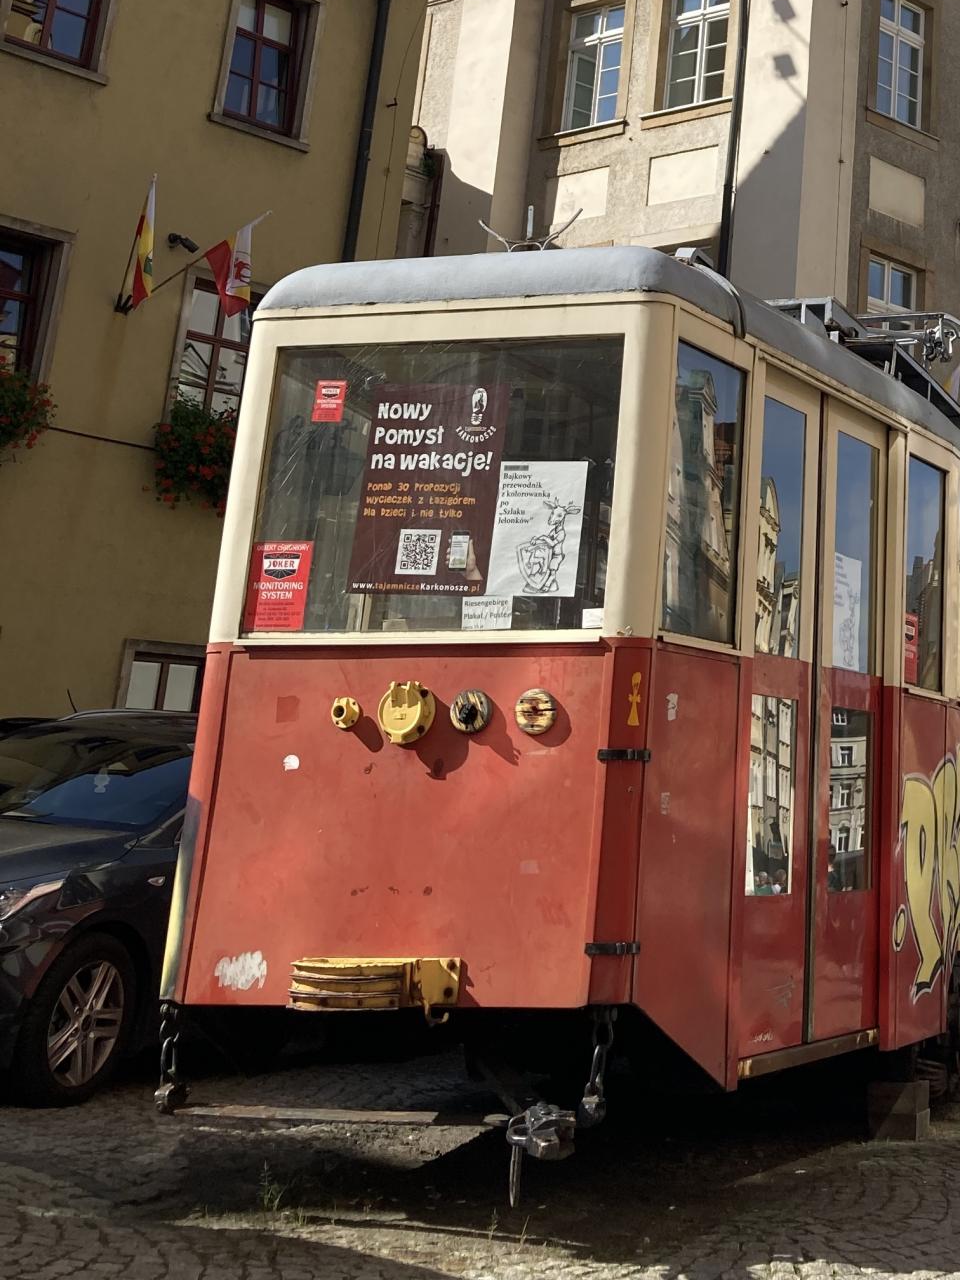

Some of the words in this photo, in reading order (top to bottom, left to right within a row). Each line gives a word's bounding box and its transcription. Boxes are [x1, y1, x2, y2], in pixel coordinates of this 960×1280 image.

[370, 453, 396, 470] na
[400, 451, 493, 477] wakacje!
[503, 472, 532, 481] Bajkowy
[397, 482, 410, 492] 30
[502, 482, 542, 490] przewodnik
[506, 490, 551, 499] kolorowanką
[420, 508, 434, 518] nie
[266, 560, 295, 569] JOKER
[253, 581, 304, 590] MONITORING
[261, 591, 293, 600] SYSTEM
